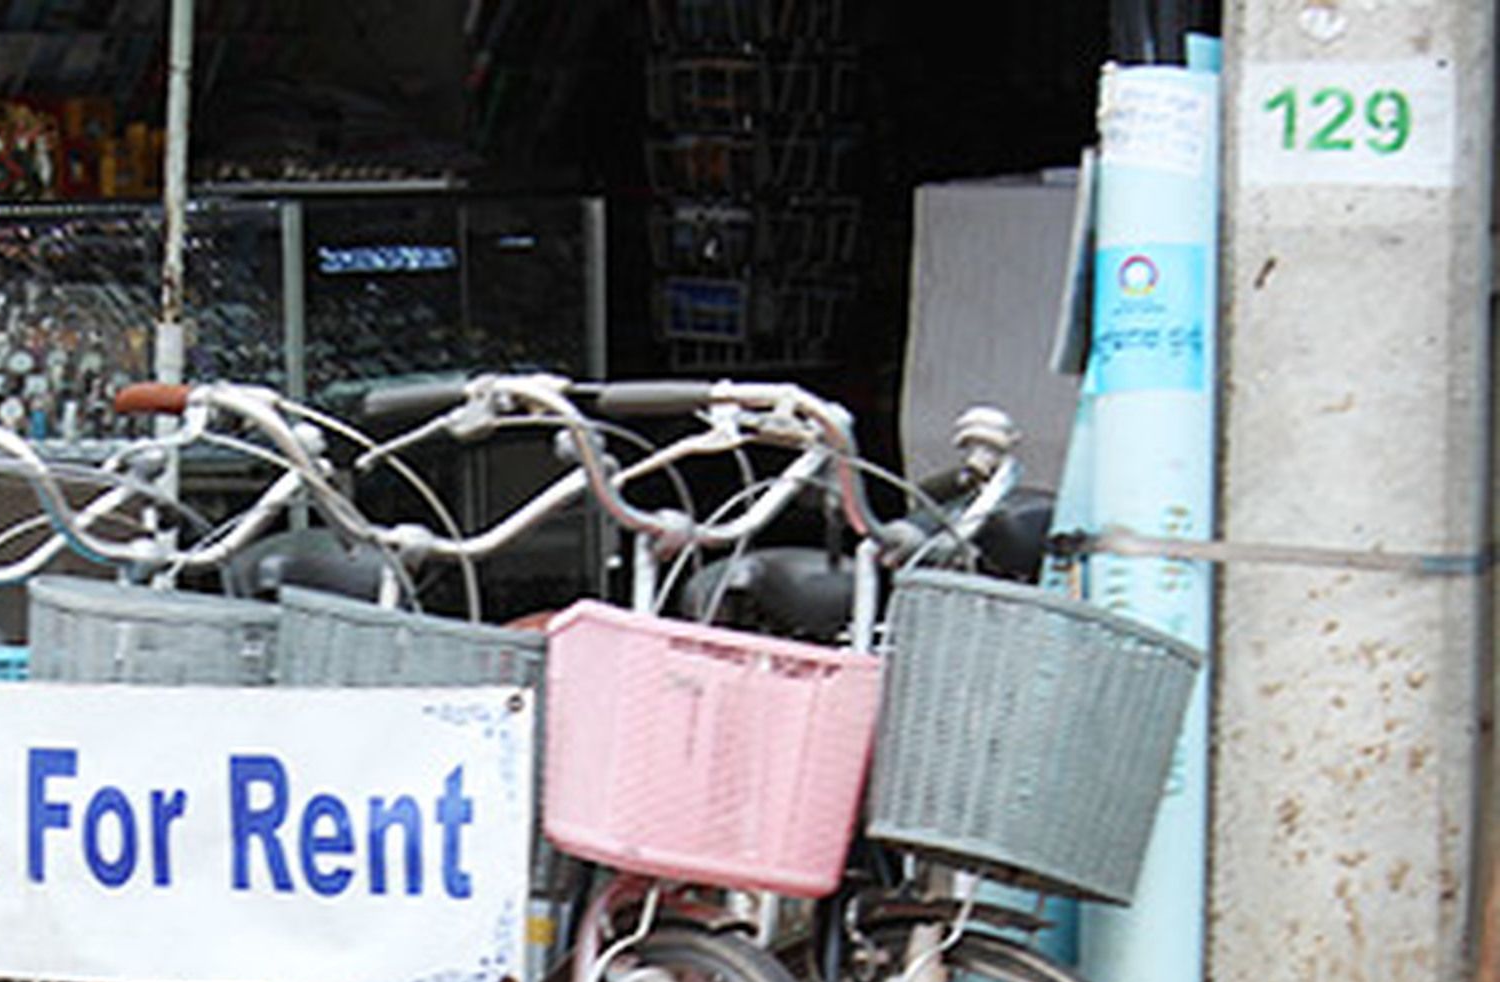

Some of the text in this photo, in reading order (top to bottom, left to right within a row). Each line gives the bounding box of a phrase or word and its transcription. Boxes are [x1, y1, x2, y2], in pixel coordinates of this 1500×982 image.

[1263, 86, 1413, 154] 129
[27, 747, 187, 888] For
[228, 754, 474, 900] Rent
